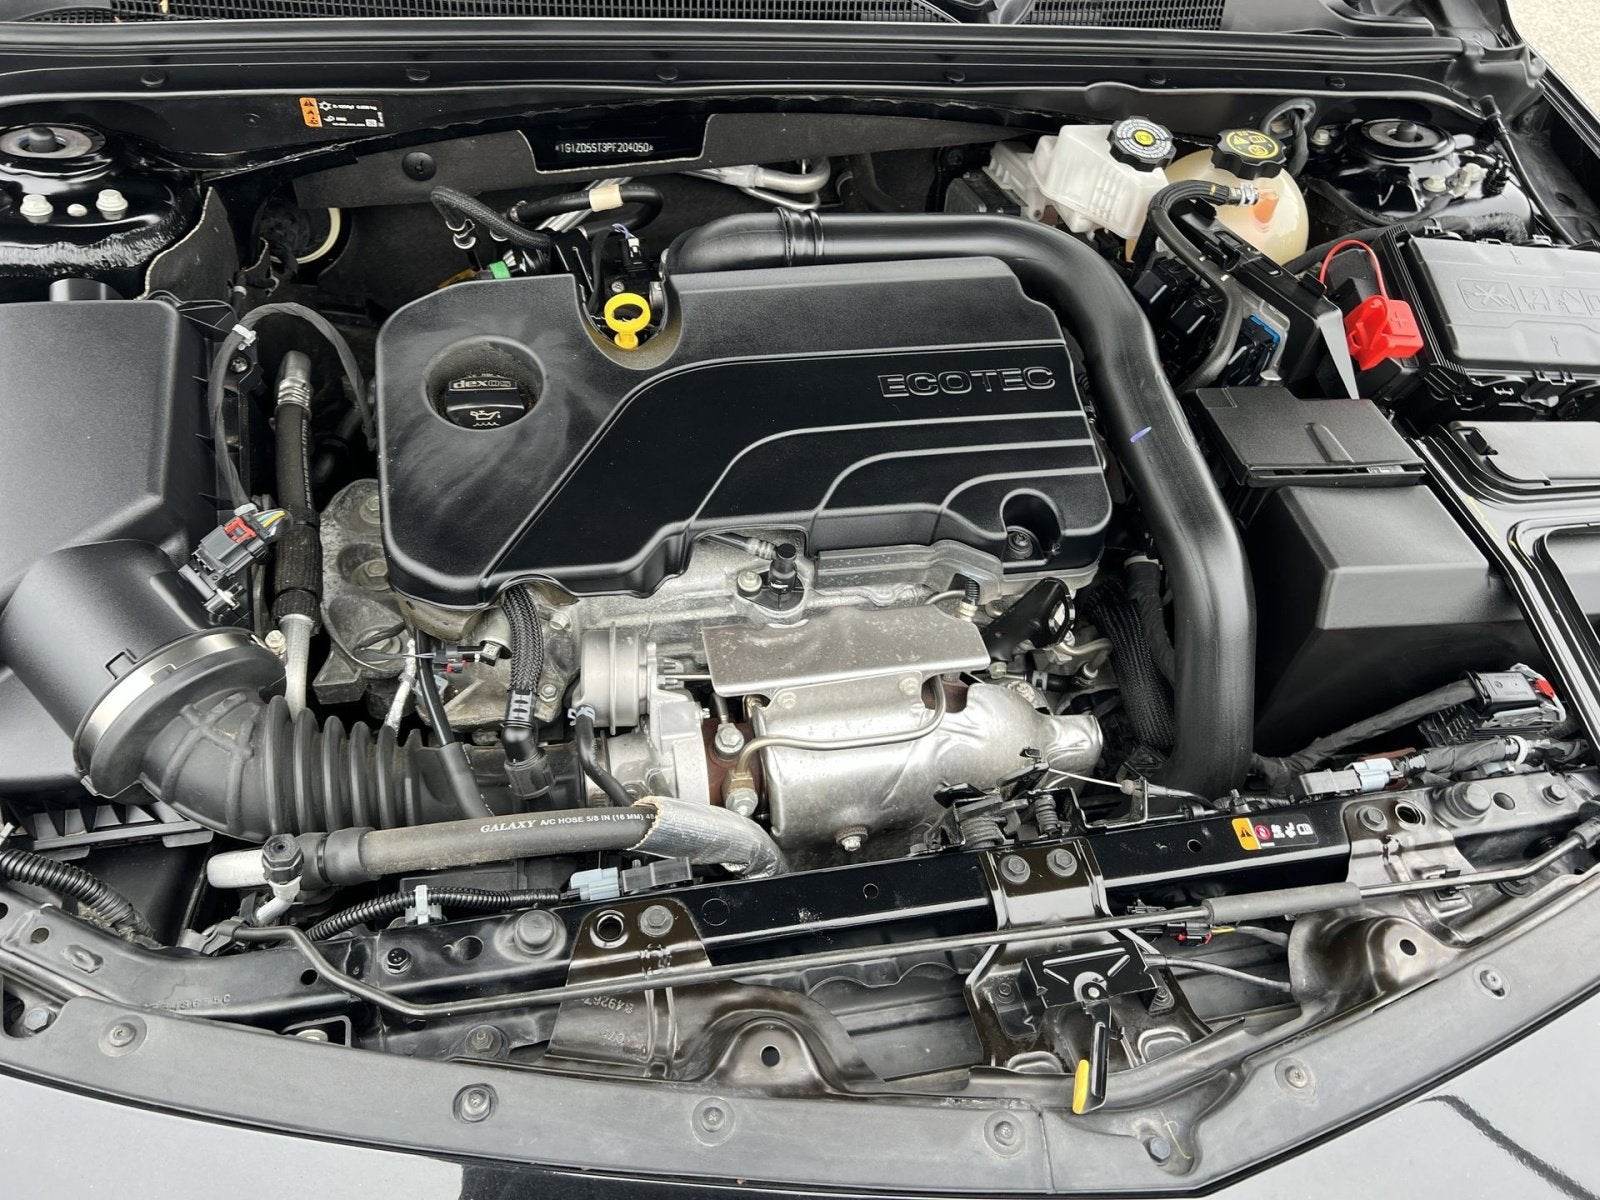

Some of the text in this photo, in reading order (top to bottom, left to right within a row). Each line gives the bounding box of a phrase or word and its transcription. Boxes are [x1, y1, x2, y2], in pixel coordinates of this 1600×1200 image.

[877, 366, 1056, 398] ECOTEC
[480, 819, 537, 833] GALAXY
[540, 818, 556, 827] A/C
[558, 815, 585, 825] HOSE
[586, 814, 599, 823] 5/8
[601, 814, 611, 822] IN
[612, 814, 625, 822] (16
[627, 813, 644, 821] MM)
